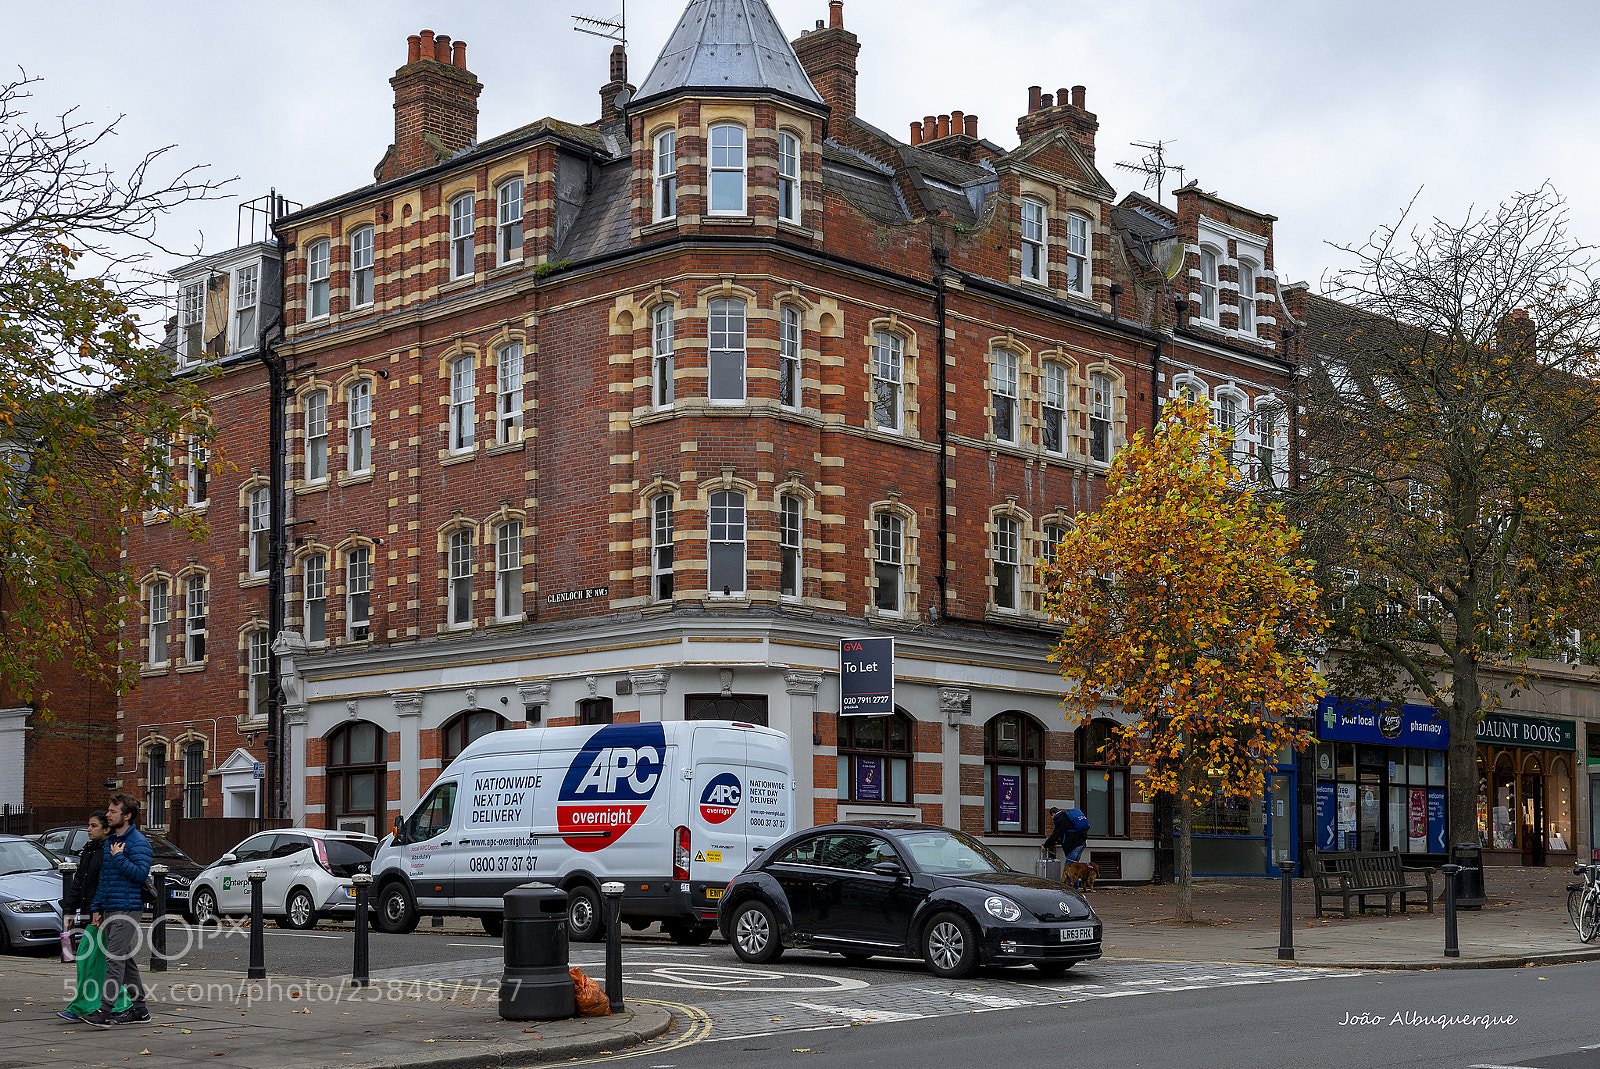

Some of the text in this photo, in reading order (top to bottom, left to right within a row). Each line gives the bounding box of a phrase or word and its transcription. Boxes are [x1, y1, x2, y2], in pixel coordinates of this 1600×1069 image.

[548, 590, 583, 603] GLENLOCH
[843, 642, 863, 651] GVA
[844, 661, 878, 673] To Let
[843, 695, 889, 705] 020 7911 2727
[1341, 715, 1357, 726] your
[1358, 714, 1375, 726] local
[1410, 720, 1442, 735] pharmacy
[1477, 720, 1561, 743] DAUNT BOOKS
[574, 745, 659, 794] APC
[475, 775, 542, 791] NATIONWIDE
[749, 780, 785, 790] NATIONWIDE
[707, 784, 740, 804] APC
[750, 788, 766, 796] NEXT
[473, 792, 525, 806] NEXT DAY
[750, 796, 778, 805] DELIVERY
[472, 809, 521, 823] DELIVERY
[572, 808, 632, 826] overnight
[750, 818, 785, 828] 0800 37 37 37
[471, 837, 539, 847] www.apc-overnight.com
[470, 856, 537, 872] 0800 37 37 37
